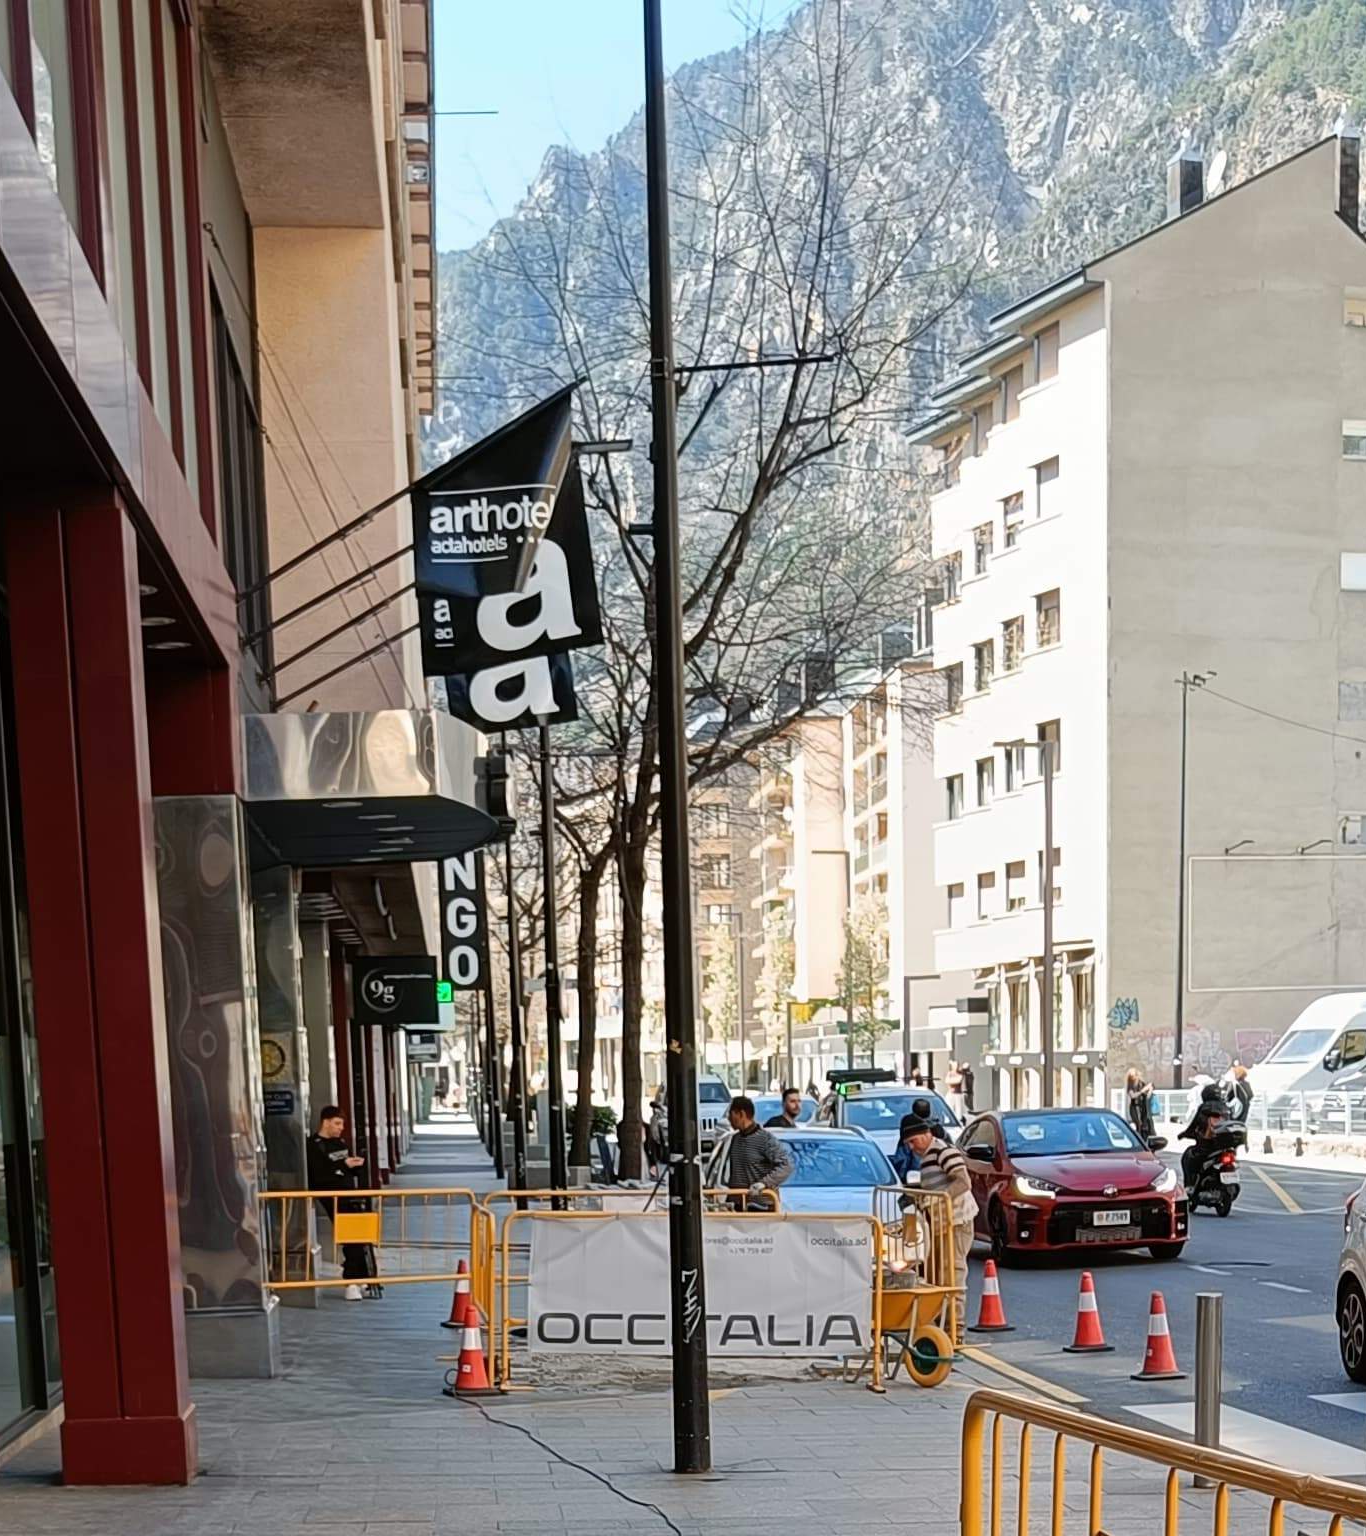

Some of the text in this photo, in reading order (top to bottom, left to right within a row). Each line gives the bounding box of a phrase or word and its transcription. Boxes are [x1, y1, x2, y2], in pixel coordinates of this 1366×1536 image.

[430, 494, 555, 534] arthotel
[431, 534, 508, 555] actahotels
[810, 1236, 867, 1247] occitalia.ad
[537, 1313, 862, 1347] OCCALIA
